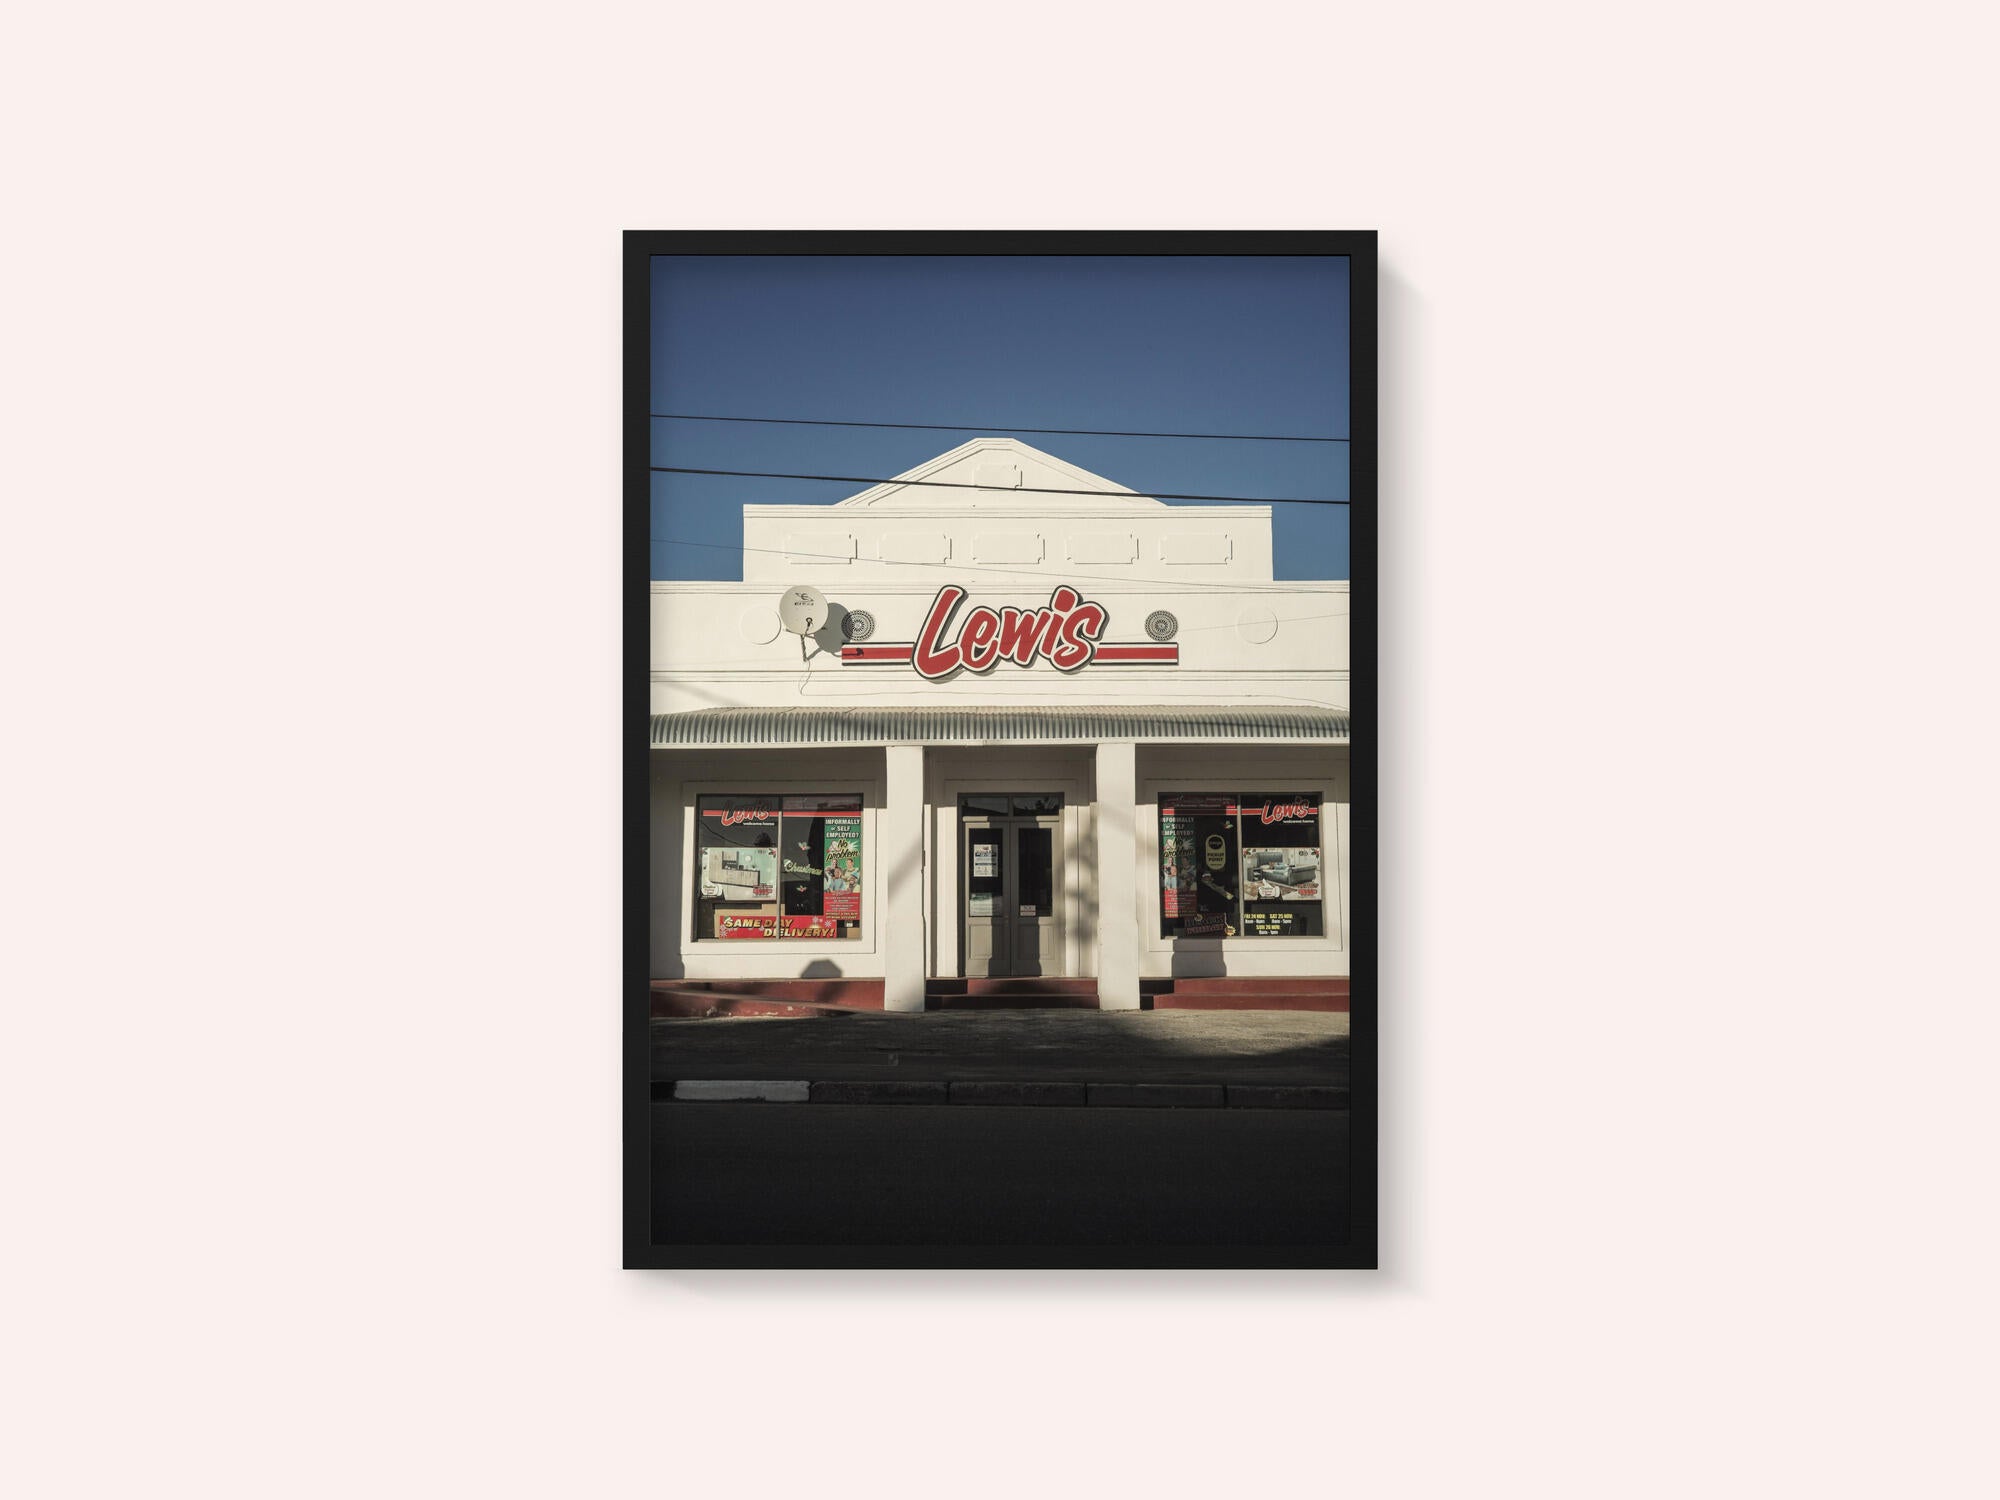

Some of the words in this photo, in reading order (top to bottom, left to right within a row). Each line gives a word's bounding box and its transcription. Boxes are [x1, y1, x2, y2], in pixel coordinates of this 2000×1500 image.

[912, 585, 1109, 681] Lewis
[721, 800, 771, 826] Lewis
[1261, 796, 1309, 824] Lewis
[837, 838, 848, 848] No
[826, 848, 859, 862] problem
[725, 918, 761, 928] SAME
[763, 919, 793, 928] DAY
[763, 928, 835, 937] DELIVERY!
